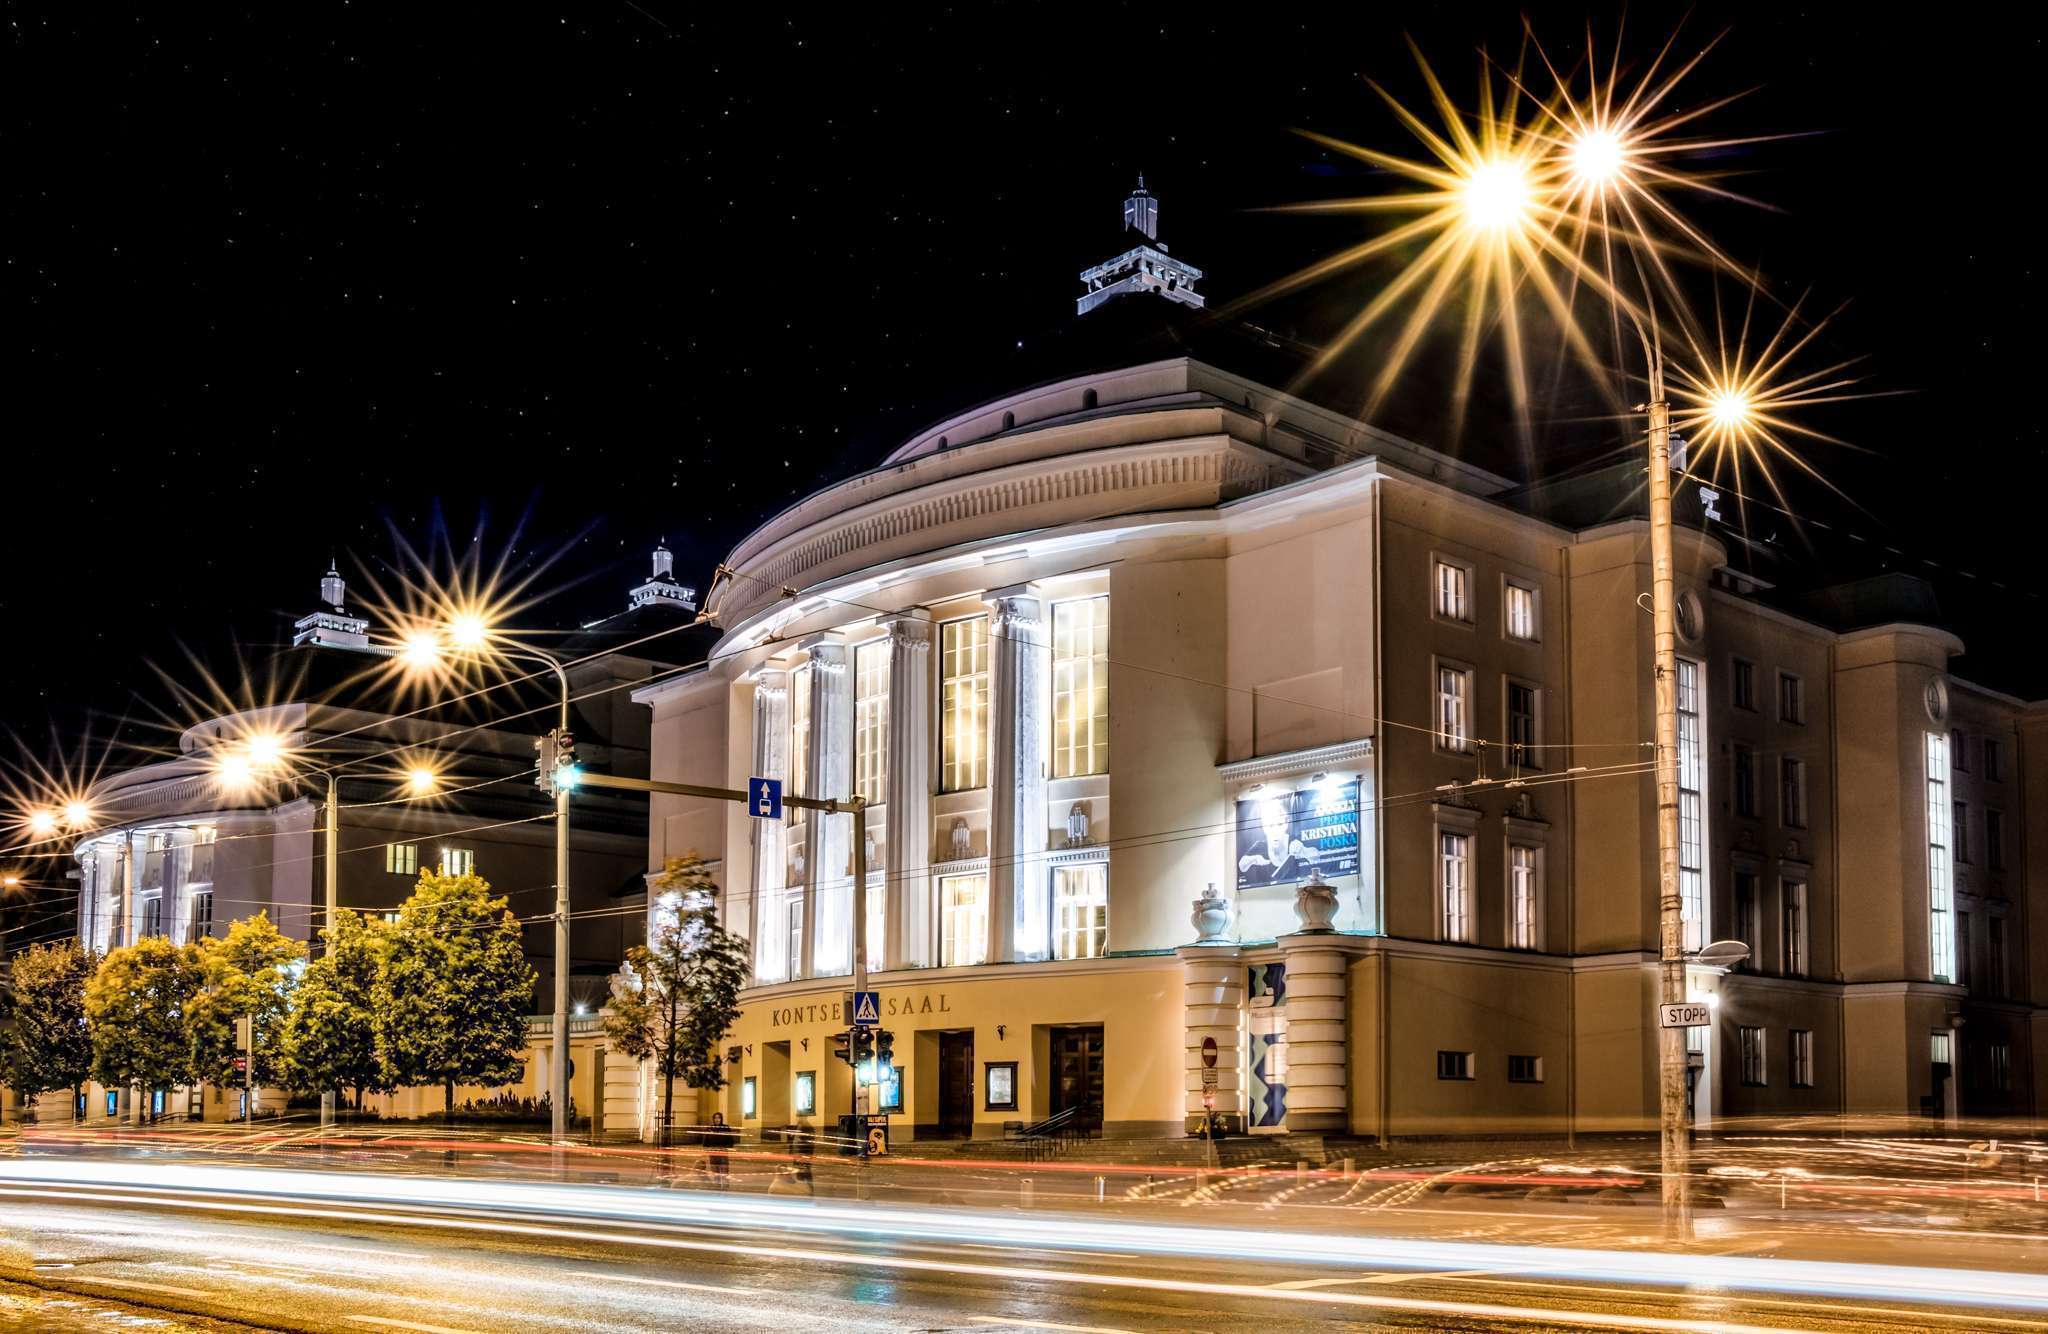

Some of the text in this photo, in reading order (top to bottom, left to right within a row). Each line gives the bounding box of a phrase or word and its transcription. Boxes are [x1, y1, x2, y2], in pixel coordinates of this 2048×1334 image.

[1301, 822, 1357, 841] KRISTIINA
[1320, 836, 1356, 849] POSKA
[1669, 1007, 1707, 1023] STOPP
